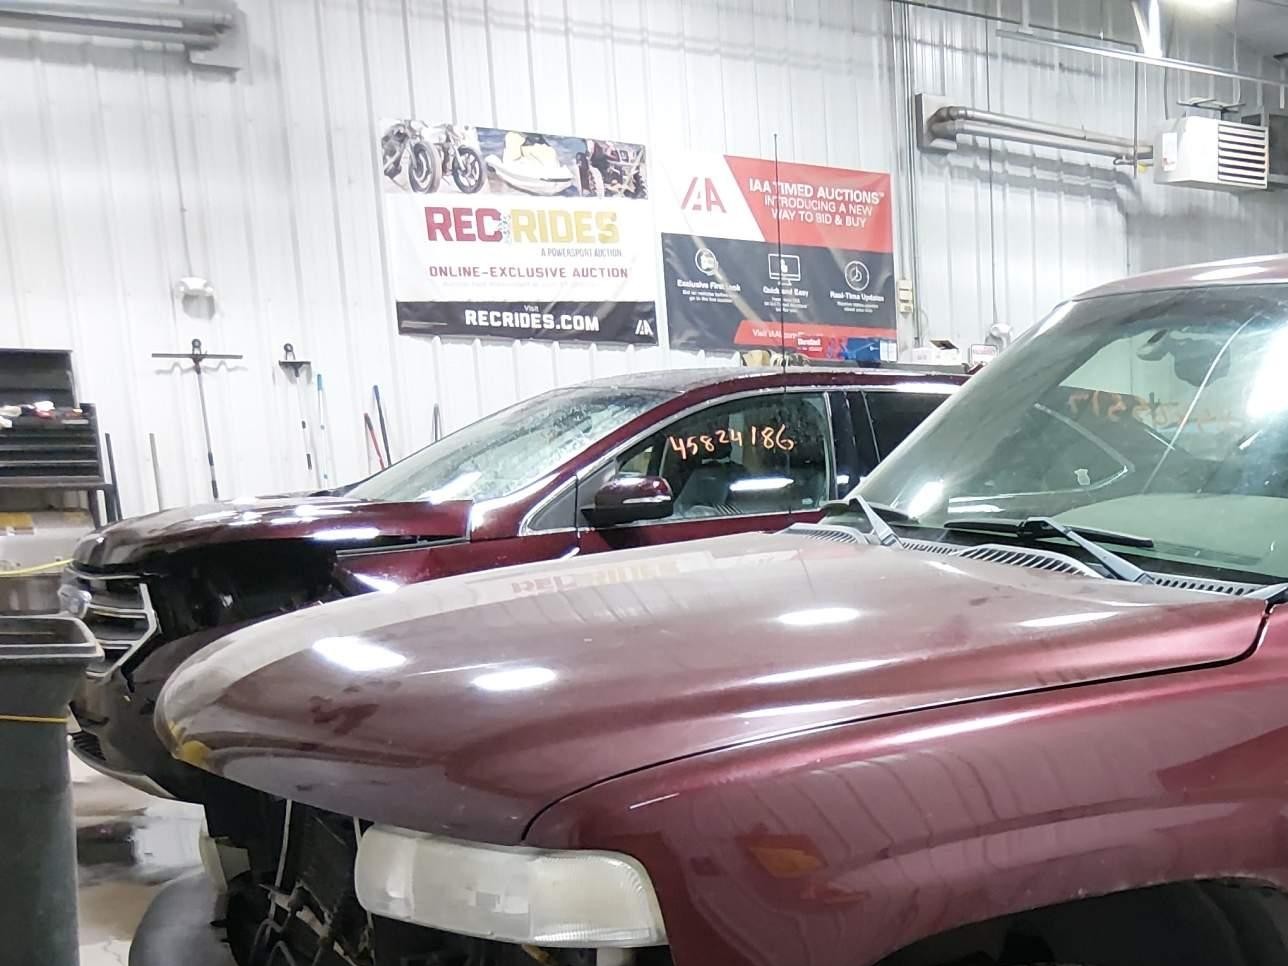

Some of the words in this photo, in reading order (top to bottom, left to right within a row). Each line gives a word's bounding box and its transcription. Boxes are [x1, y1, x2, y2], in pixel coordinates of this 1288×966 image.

[749, 178, 772, 194] IAA
[839, 203, 847, 214] A
[849, 204, 873, 217] NEW
[799, 211, 814, 223] TO
[816, 213, 832, 225] BID
[834, 215, 843, 226] &
[845, 216, 867, 228] BUY
[429, 265, 566, 279] ONLINE-EXCLUSIVE
[572, 267, 629, 279] AUCTION
[524, 304, 539, 312] Visit
[464, 309, 600, 332] RECRIDES.COM
[669, 423, 795, 460] 45824186
